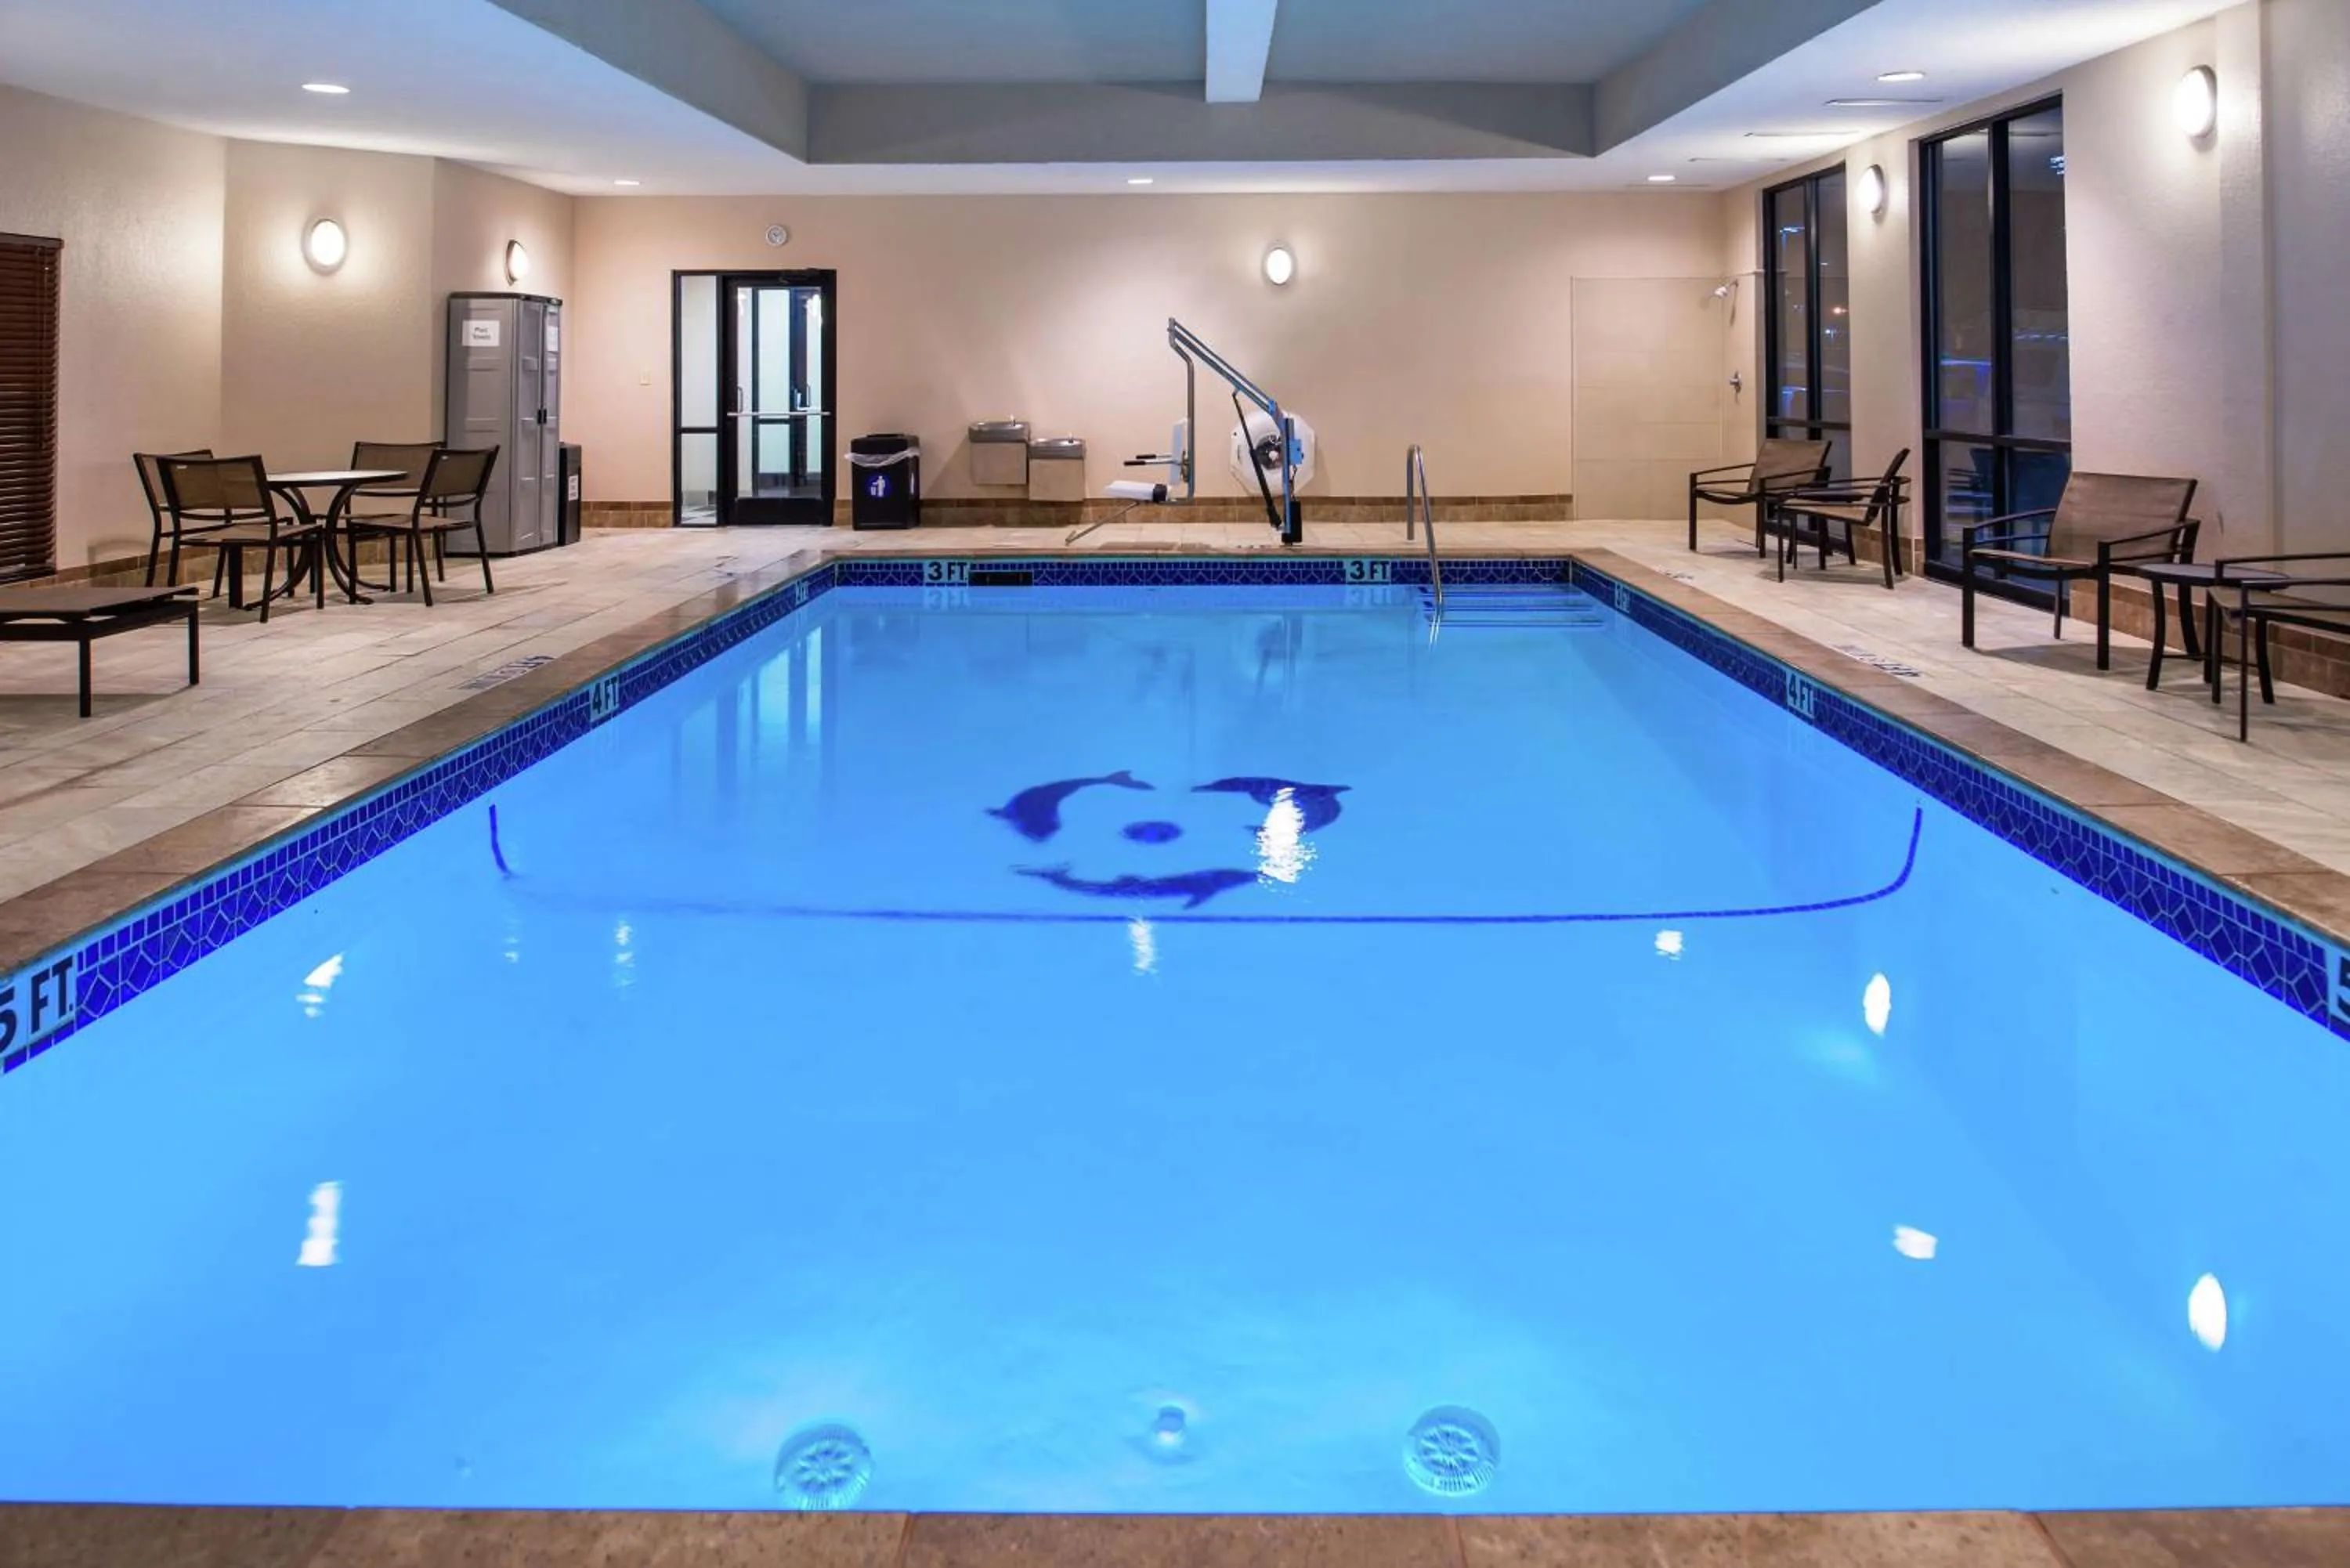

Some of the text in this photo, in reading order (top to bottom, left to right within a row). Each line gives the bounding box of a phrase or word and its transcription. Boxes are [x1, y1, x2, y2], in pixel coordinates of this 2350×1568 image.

[928, 562, 942, 580] 3
[1350, 561, 1389, 580] 3 FT
[592, 682, 602, 714] 4
[1788, 674, 1797, 705] 4
[31, 956, 73, 1034] FT.
